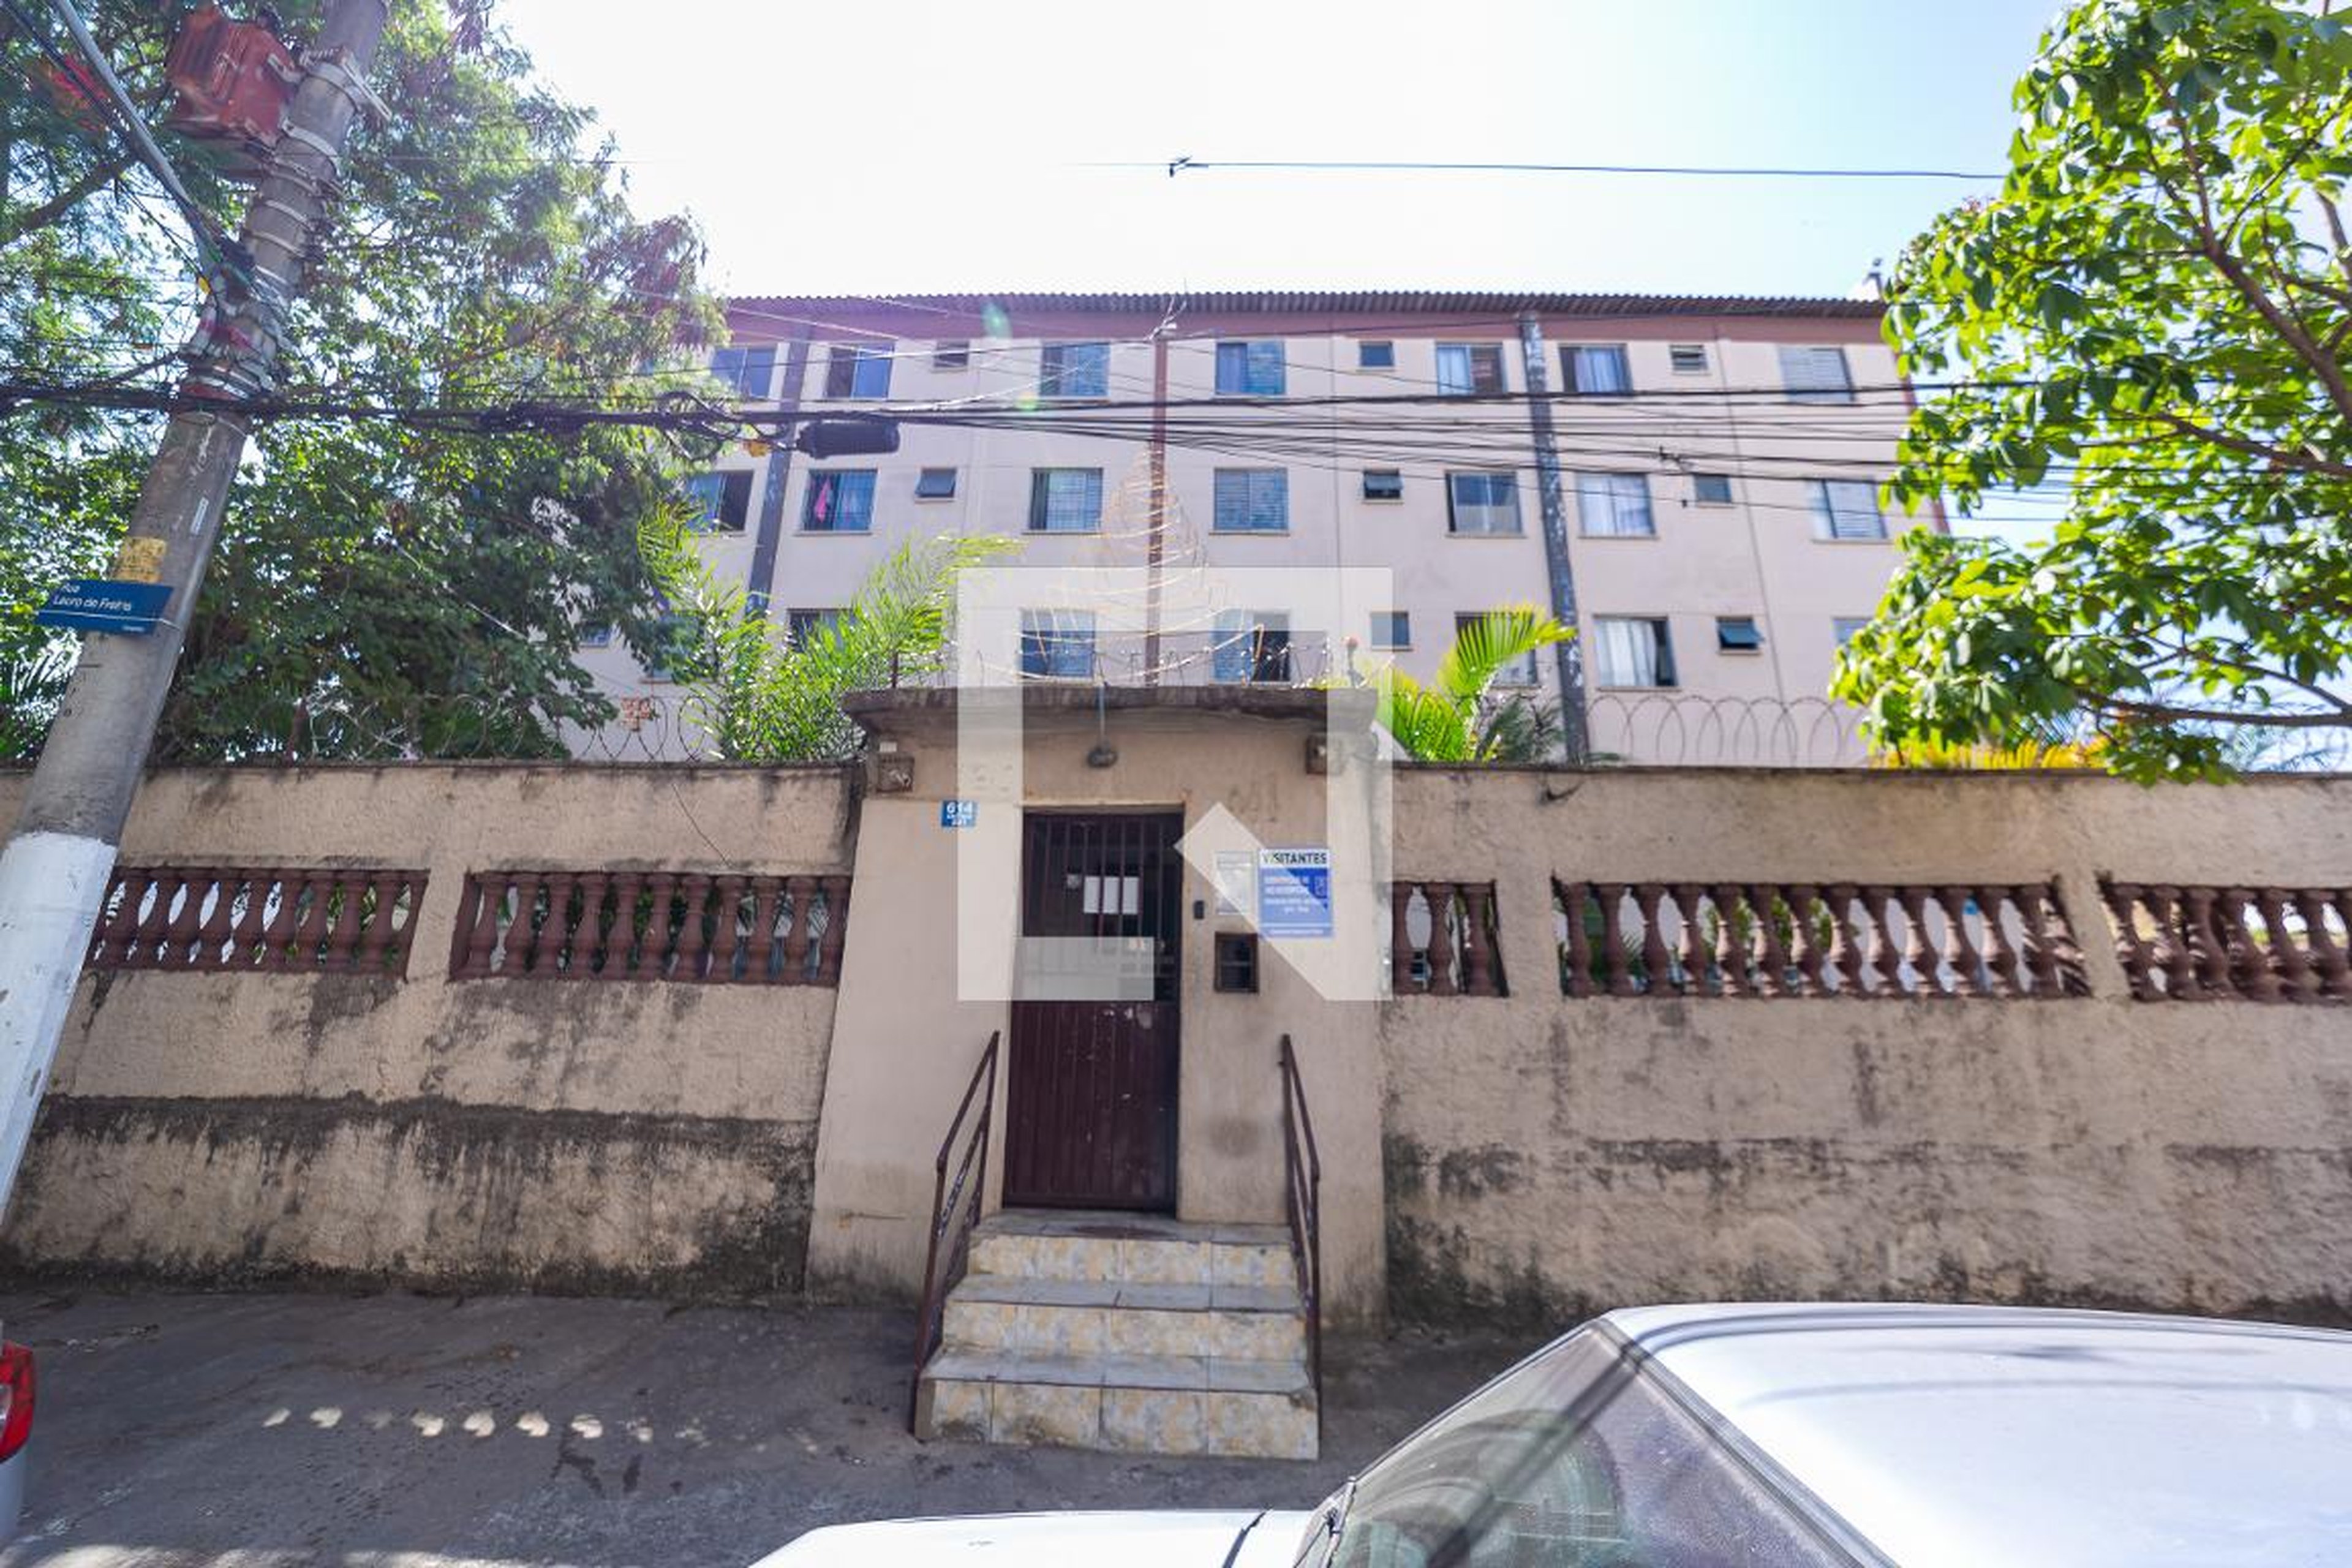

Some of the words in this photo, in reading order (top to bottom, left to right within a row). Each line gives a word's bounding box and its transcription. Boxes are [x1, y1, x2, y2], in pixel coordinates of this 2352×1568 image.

[83, 597, 97, 608] de
[946, 801, 973, 814] 614
[1263, 853, 1327, 865] VISITANTES
